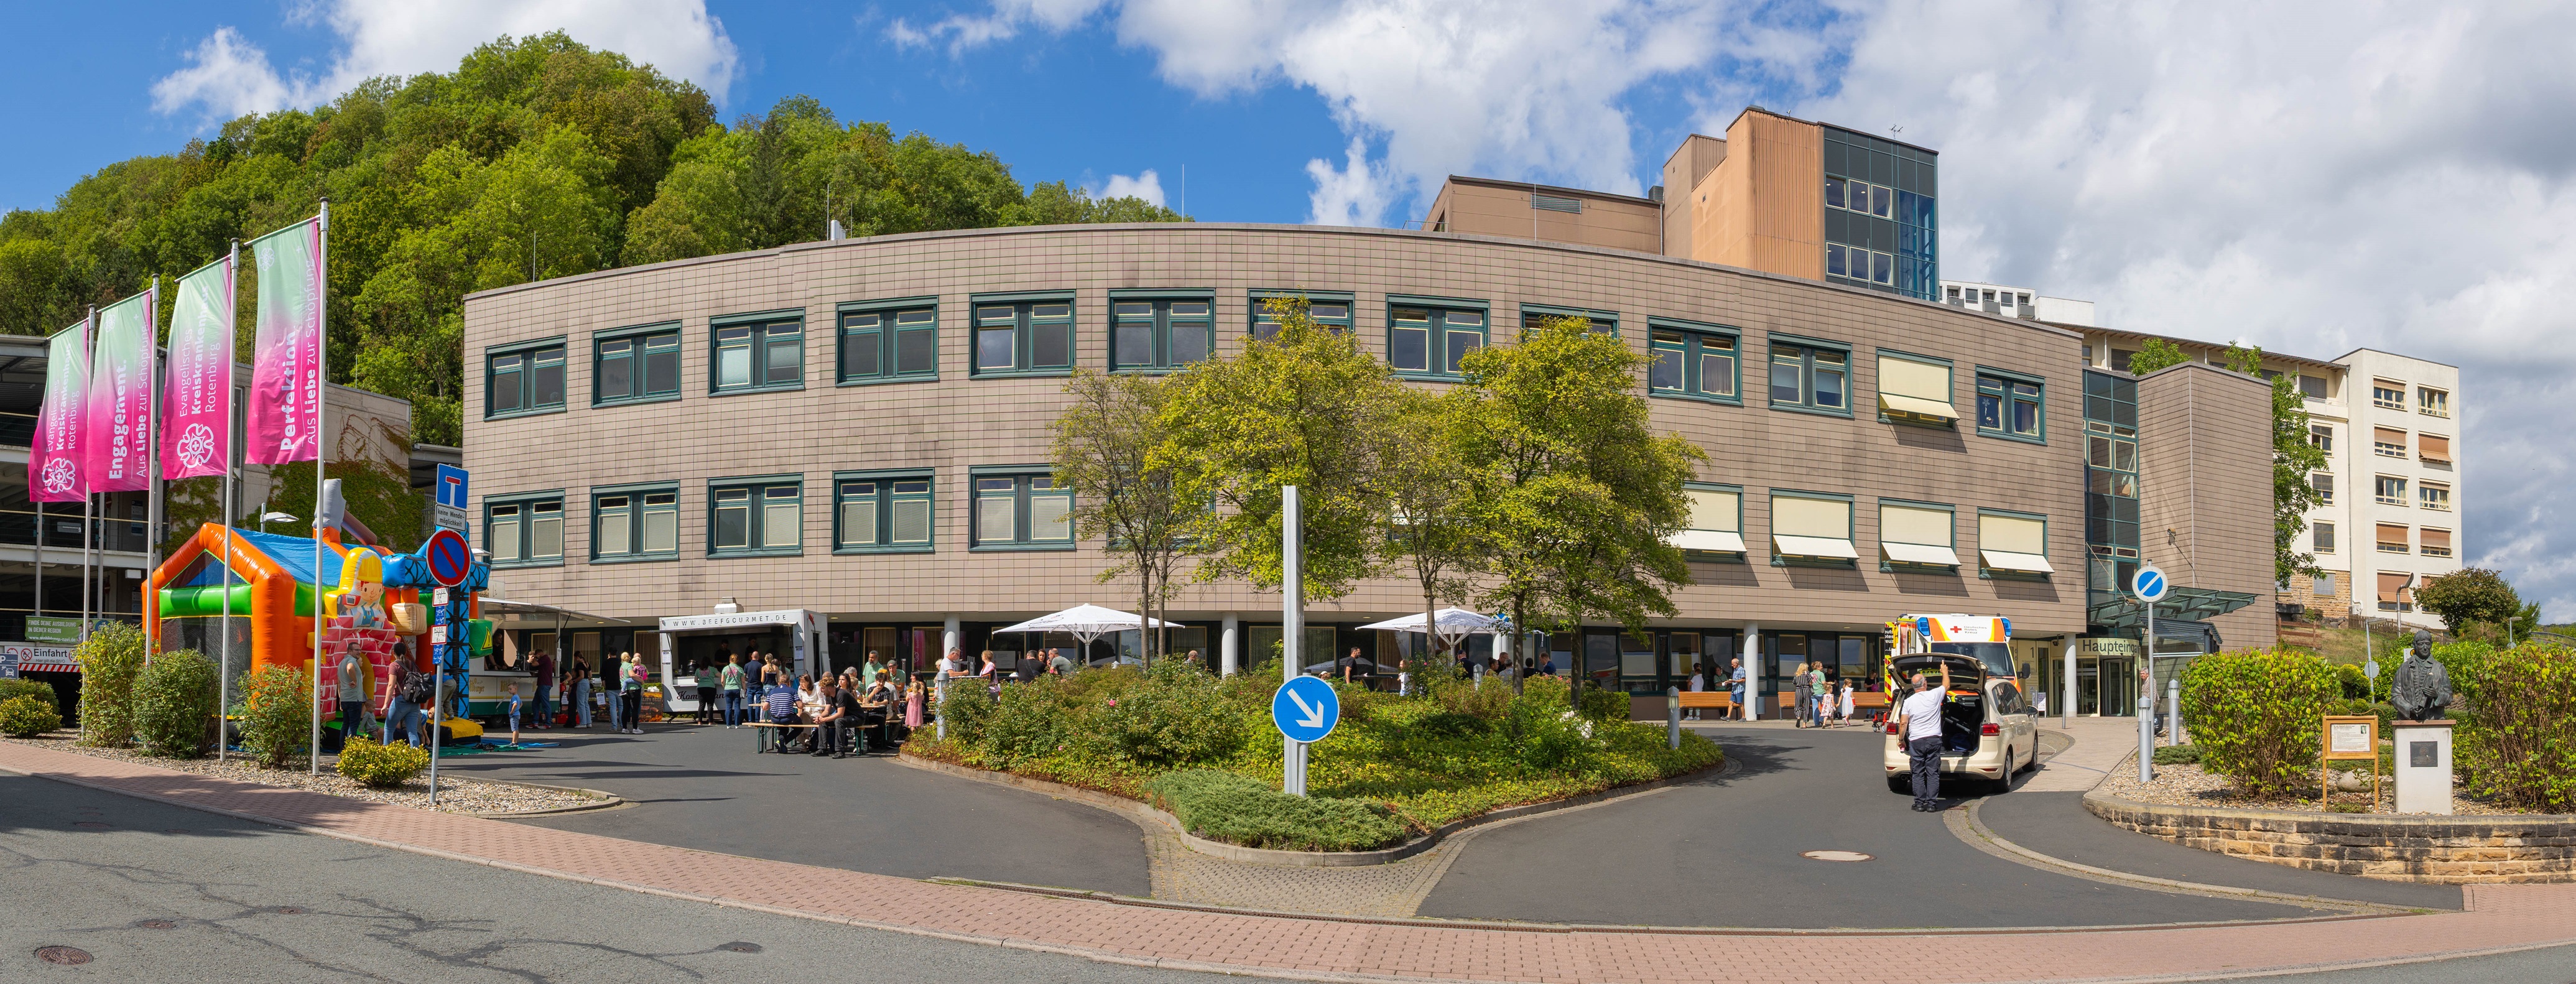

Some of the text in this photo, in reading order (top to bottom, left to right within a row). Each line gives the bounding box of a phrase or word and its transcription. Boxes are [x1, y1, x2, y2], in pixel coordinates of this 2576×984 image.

[191, 285, 209, 415] Kreiskrankenhaus
[305, 258, 318, 445] Aus Liebe zur Schöpfung
[180, 328, 193, 417] Evangelisches
[205, 343, 221, 412] Rotenburg
[56, 343, 72, 450] Kreiskrankenhaus
[139, 392, 147, 412] zur
[46, 379, 60, 452] Evangelisches
[68, 390, 80, 450] Rotenburg
[109, 359, 129, 480] Engagement.
[137, 415, 147, 452] Liebe
[136, 455, 147, 478] Aus
[437, 508, 465, 519] keine Wende-
[439, 518, 462, 527] möglichkeit
[673, 615, 787, 627] WWW.BEEFGOURMET.DE
[0, 655, 6, 664] P
[34, 648, 68, 657] Einfahrt
[2030, 647, 2034, 658] 1
